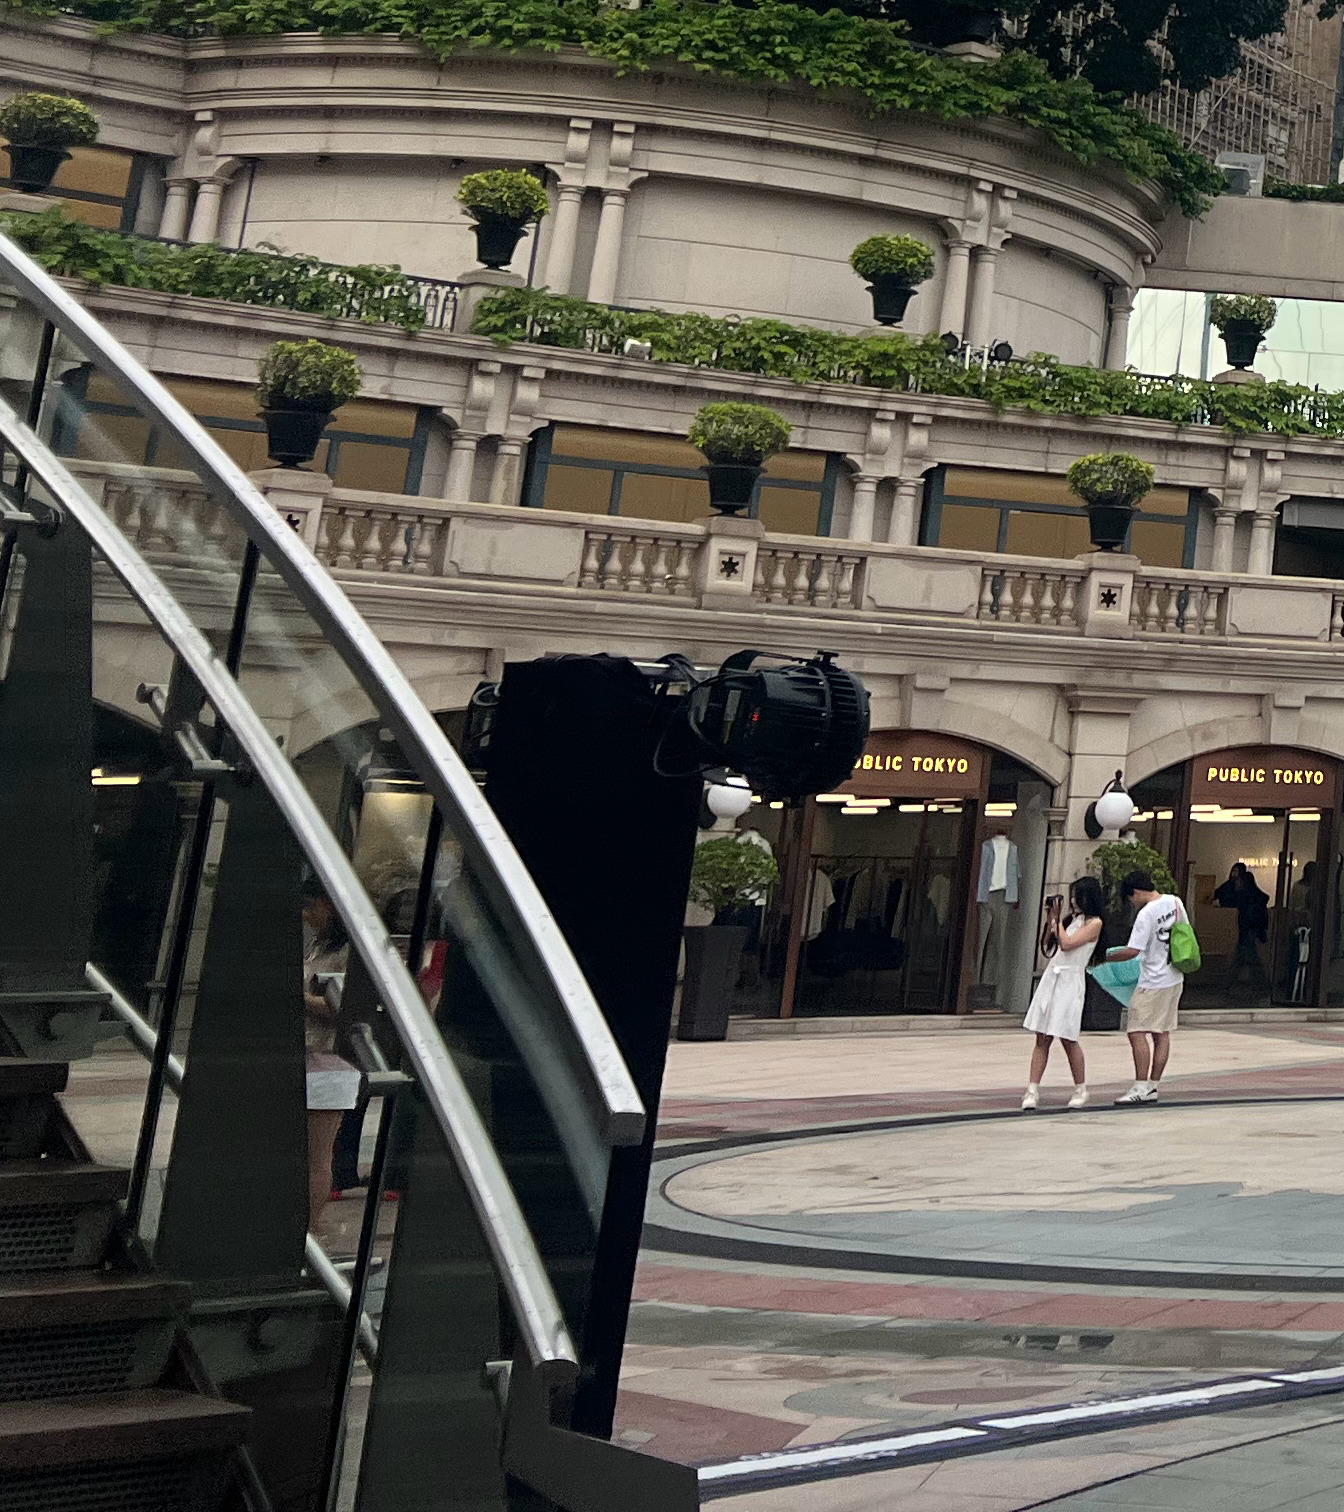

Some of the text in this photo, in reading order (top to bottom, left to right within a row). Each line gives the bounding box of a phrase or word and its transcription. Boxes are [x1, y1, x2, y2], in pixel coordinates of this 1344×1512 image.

[911, 756, 968, 773] TOKYO
[1207, 767, 1324, 785] PUBLIC TOKYO
